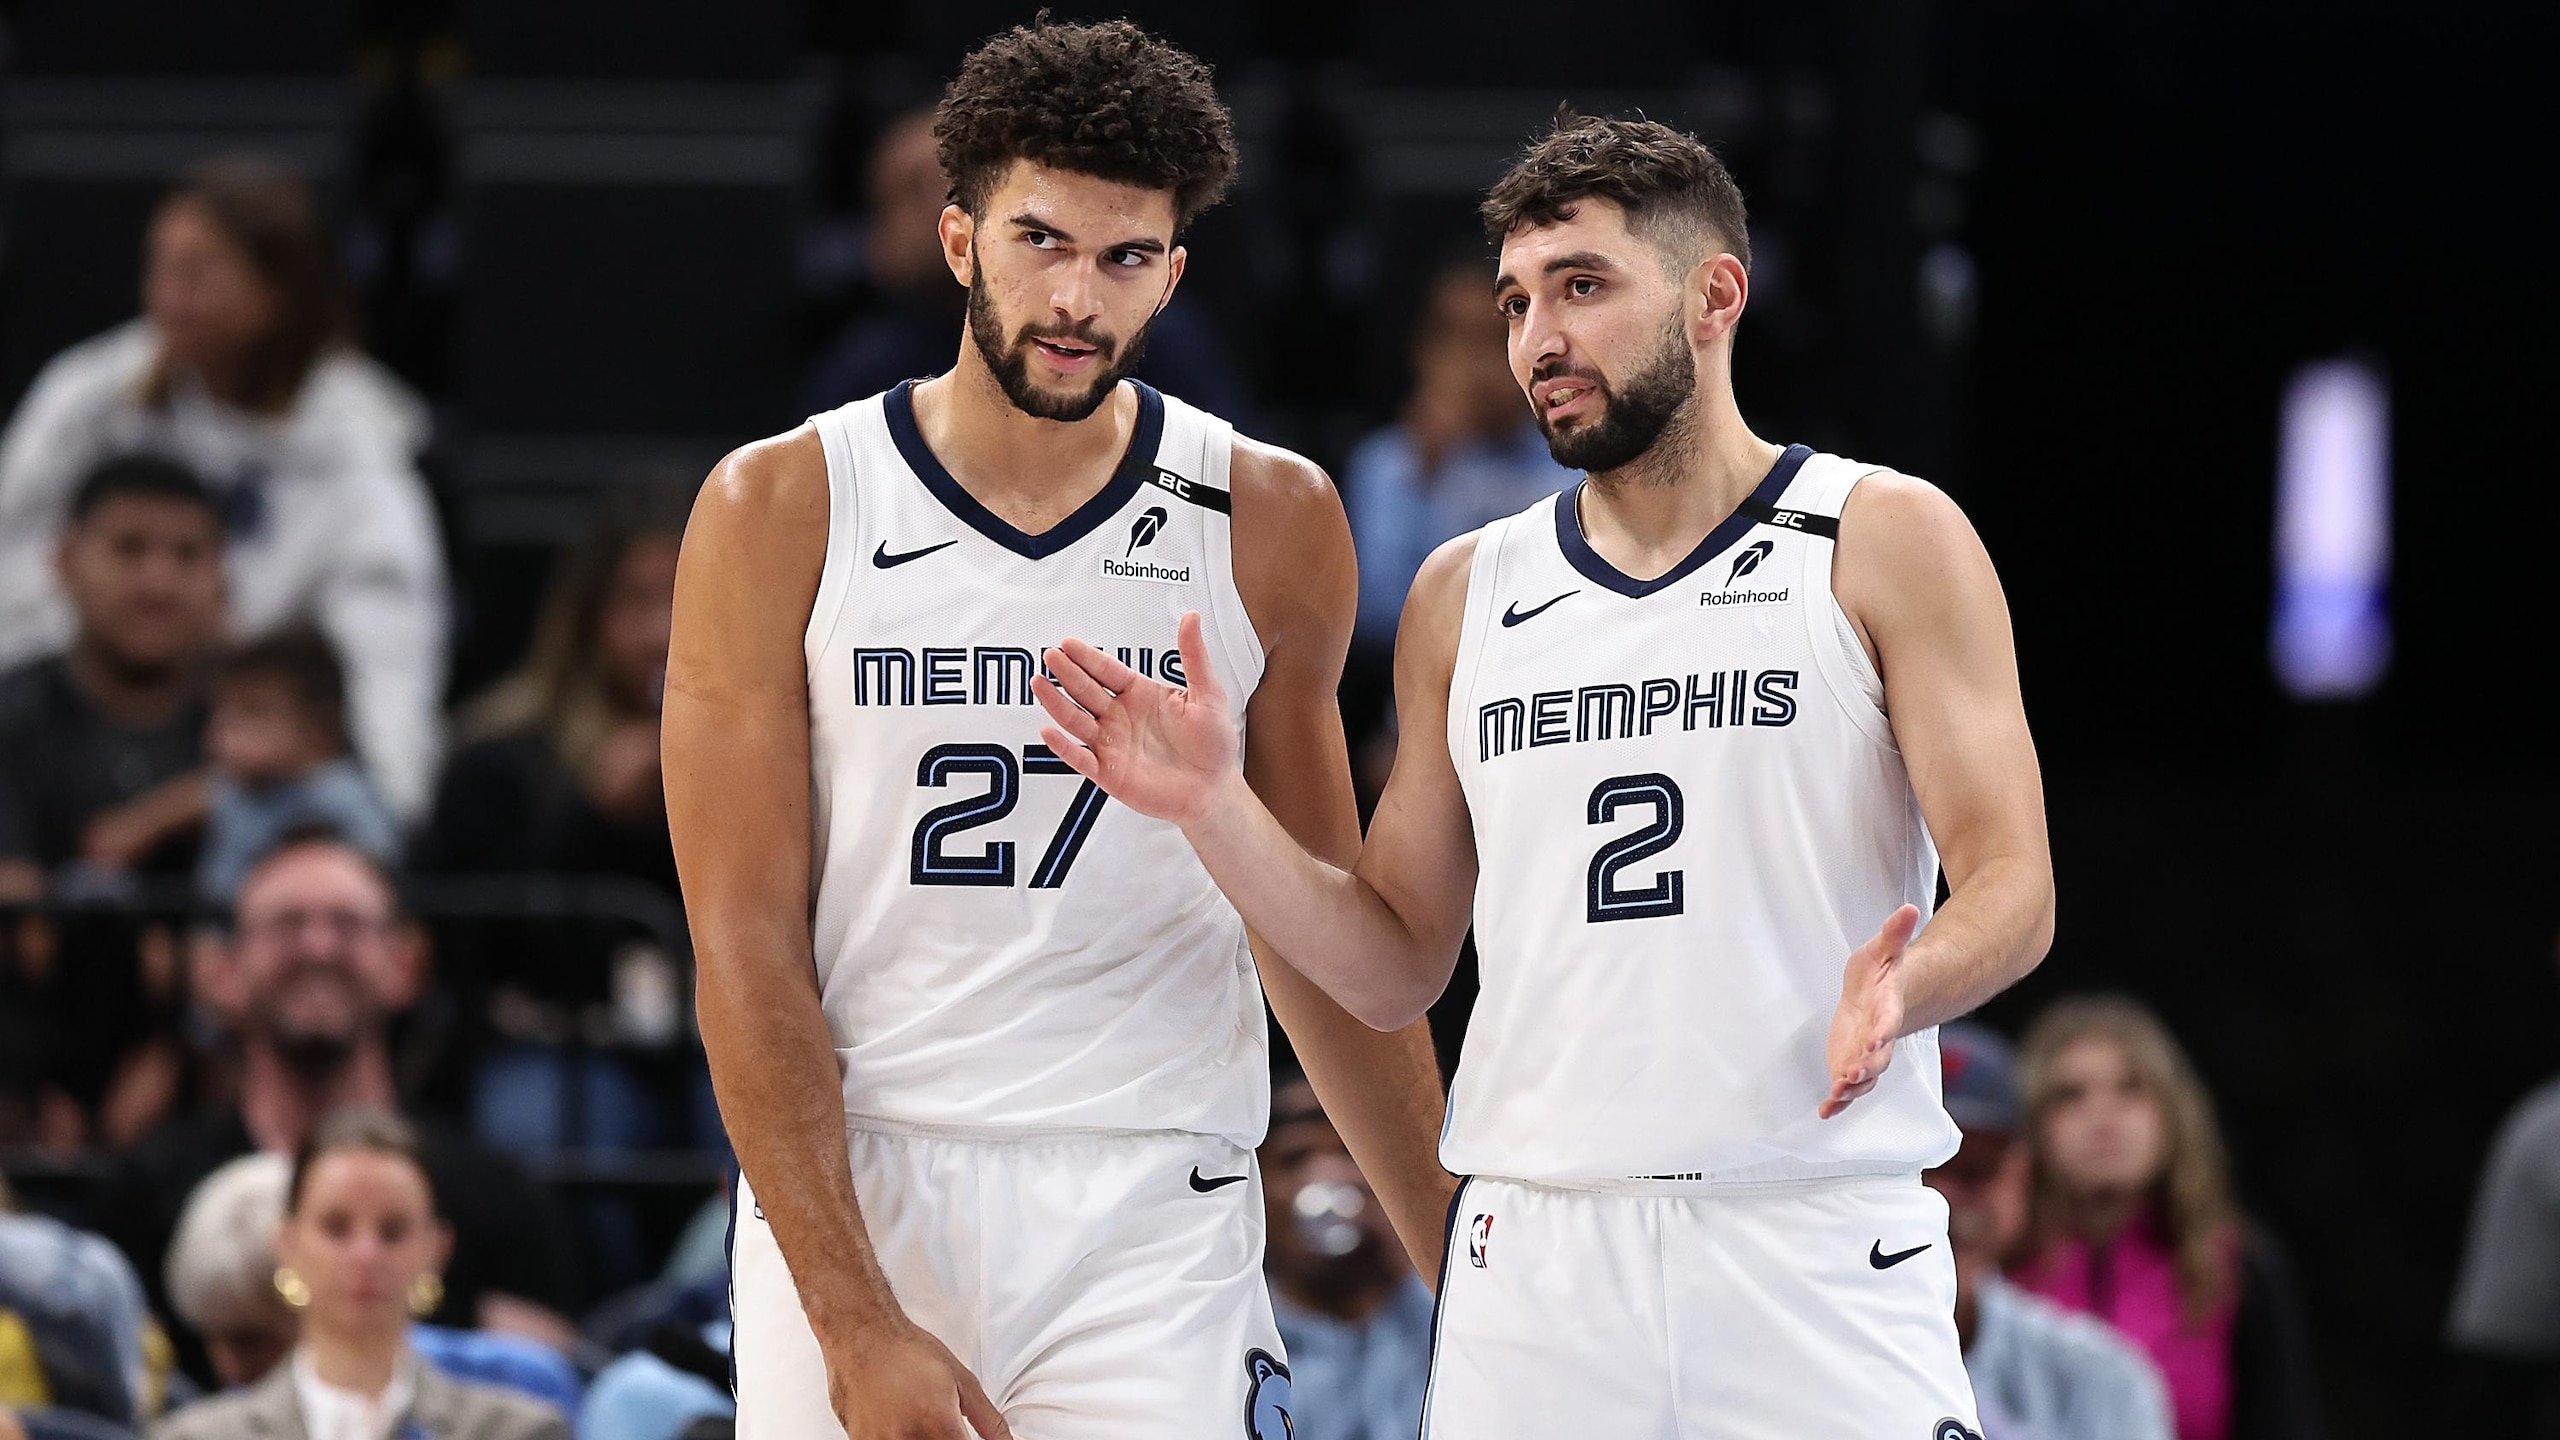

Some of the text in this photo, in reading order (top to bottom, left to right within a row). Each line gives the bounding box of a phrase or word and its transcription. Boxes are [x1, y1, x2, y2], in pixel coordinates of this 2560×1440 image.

[1158, 471, 1191, 498] BC
[1771, 511, 1806, 528] BC
[1103, 559, 1190, 582] Robinhood
[1700, 588, 1788, 606] Robinhood
[1480, 670, 1799, 762] MEMPHIS
[910, 743, 1111, 889] 27
[1587, 773, 1684, 923] 2
